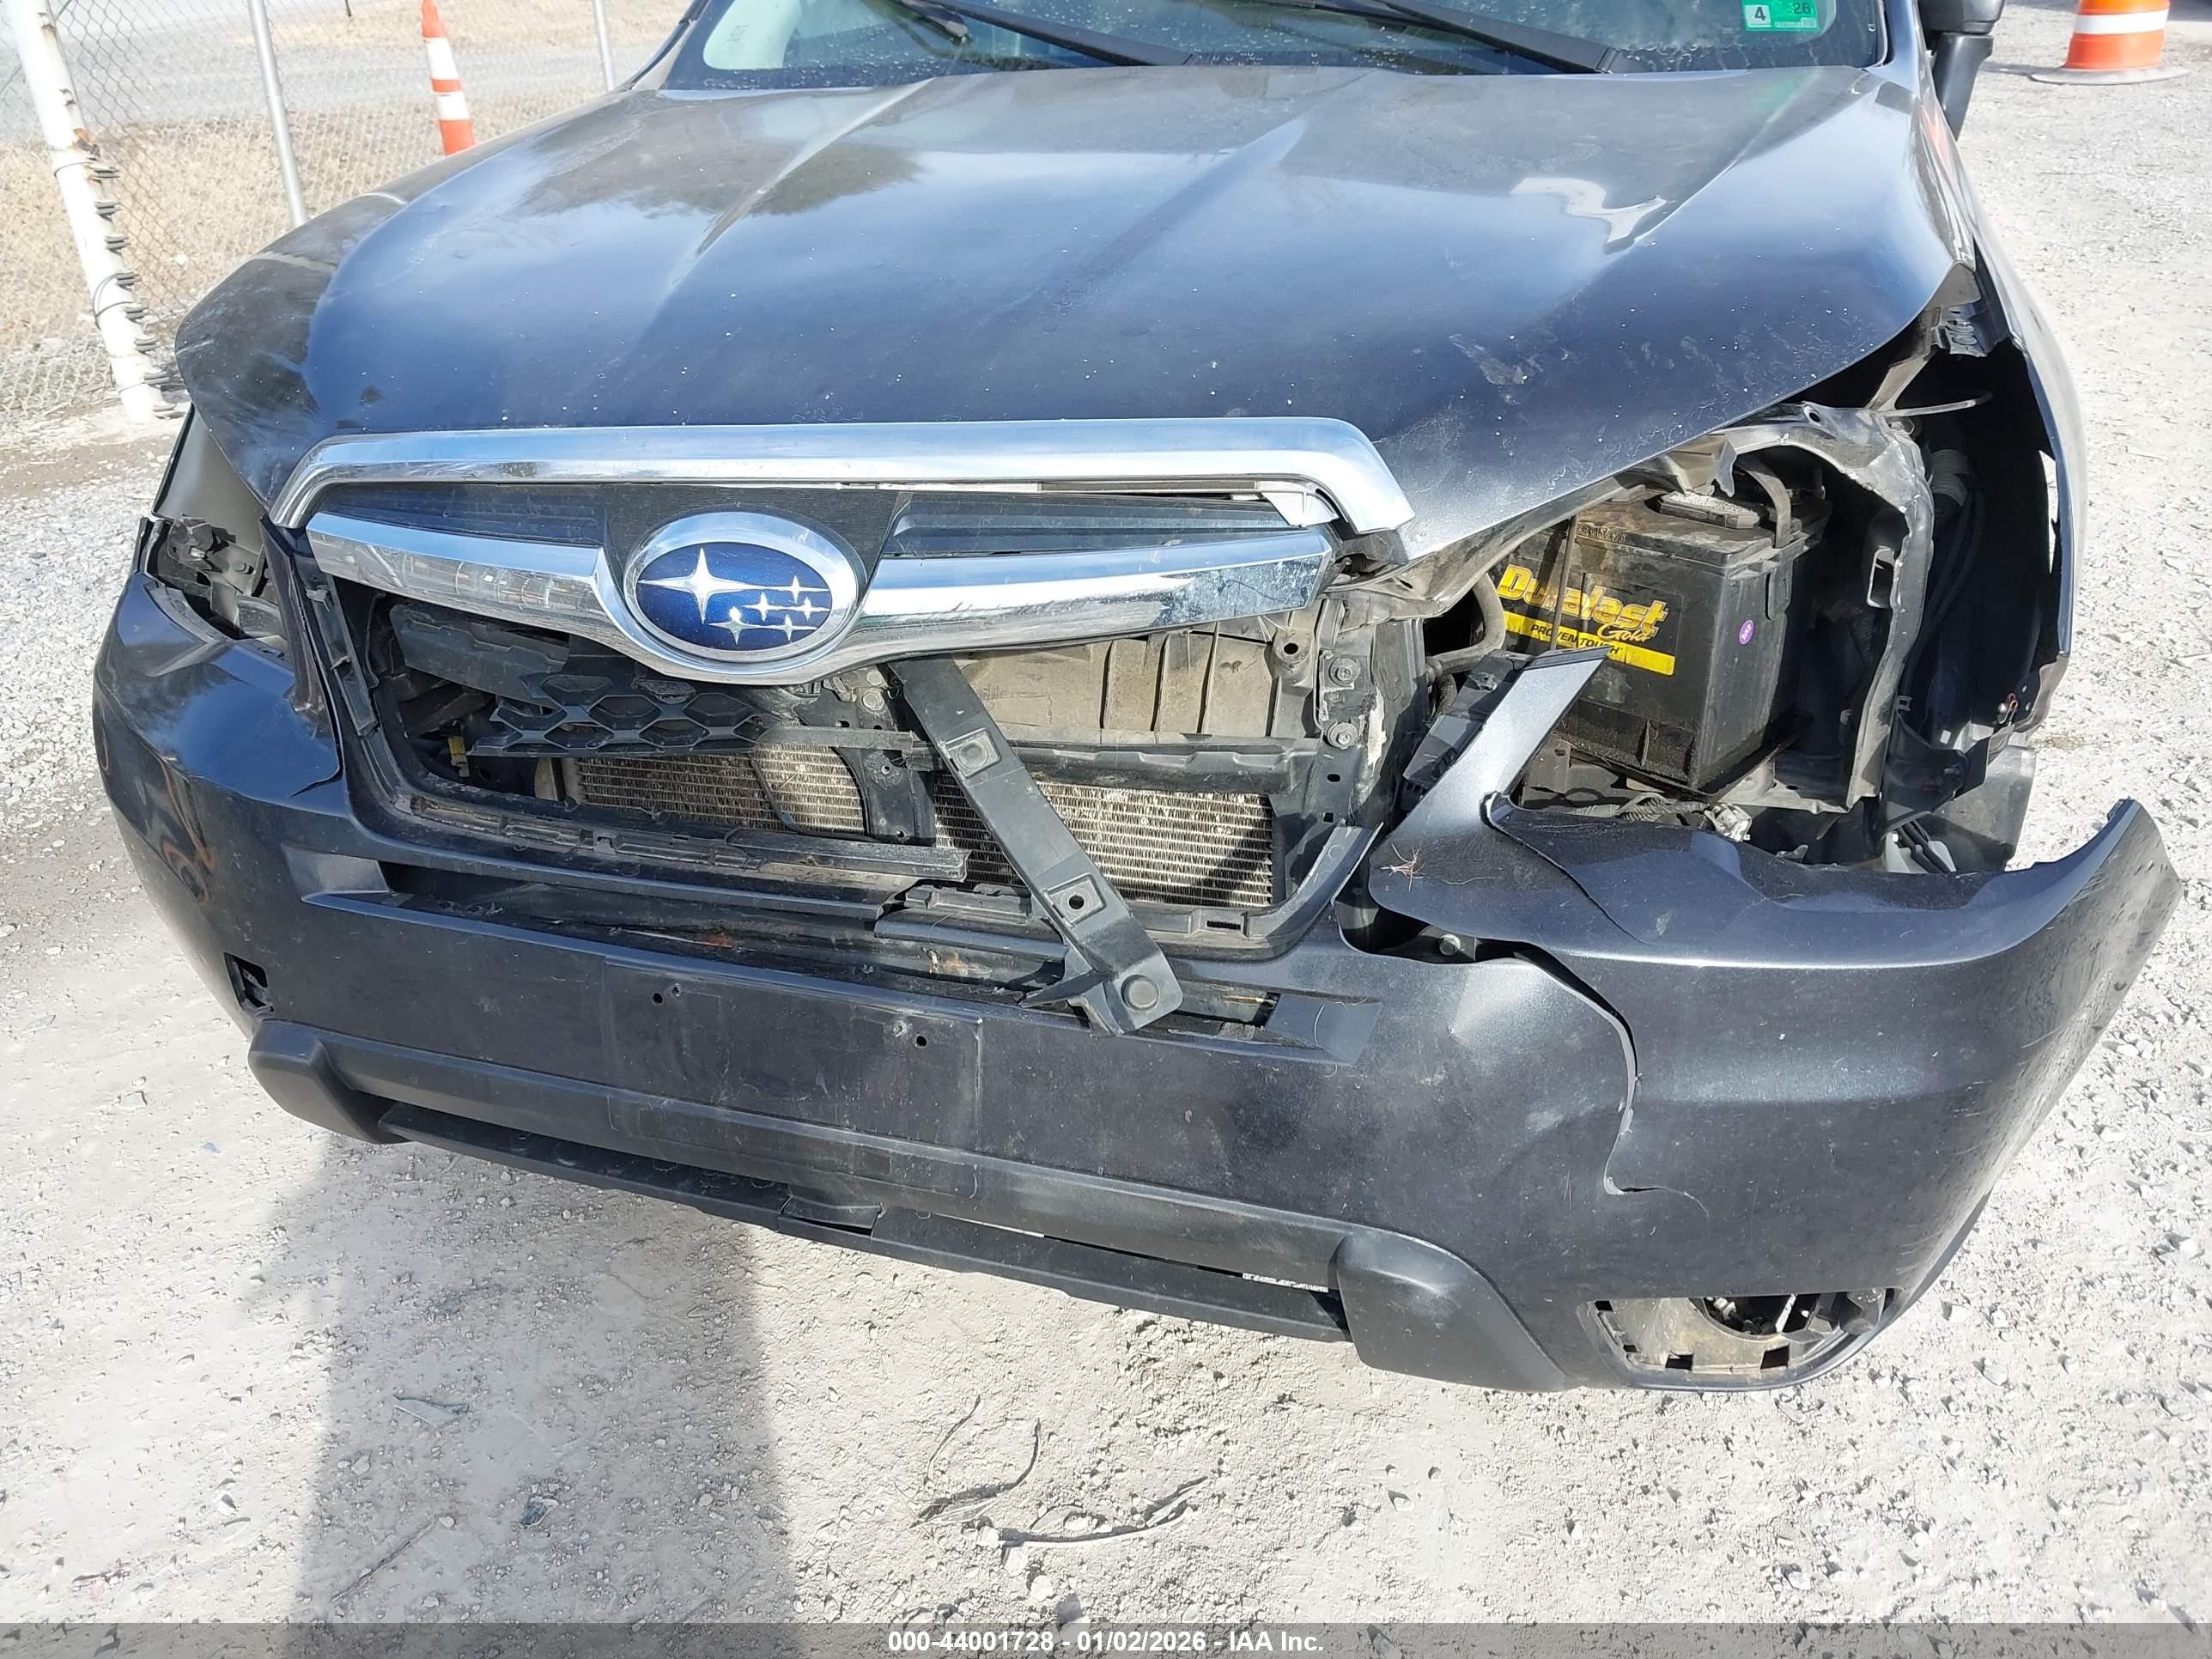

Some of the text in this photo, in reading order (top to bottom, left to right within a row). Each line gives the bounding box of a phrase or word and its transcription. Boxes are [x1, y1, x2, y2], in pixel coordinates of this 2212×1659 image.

[1754, 6, 1766, 21] 4
[1793, 2, 1812, 15] 26
[1496, 563, 1670, 637] Duralast
[1596, 623, 1652, 644] Gold
[1579, 637, 1620, 655] TOUH
